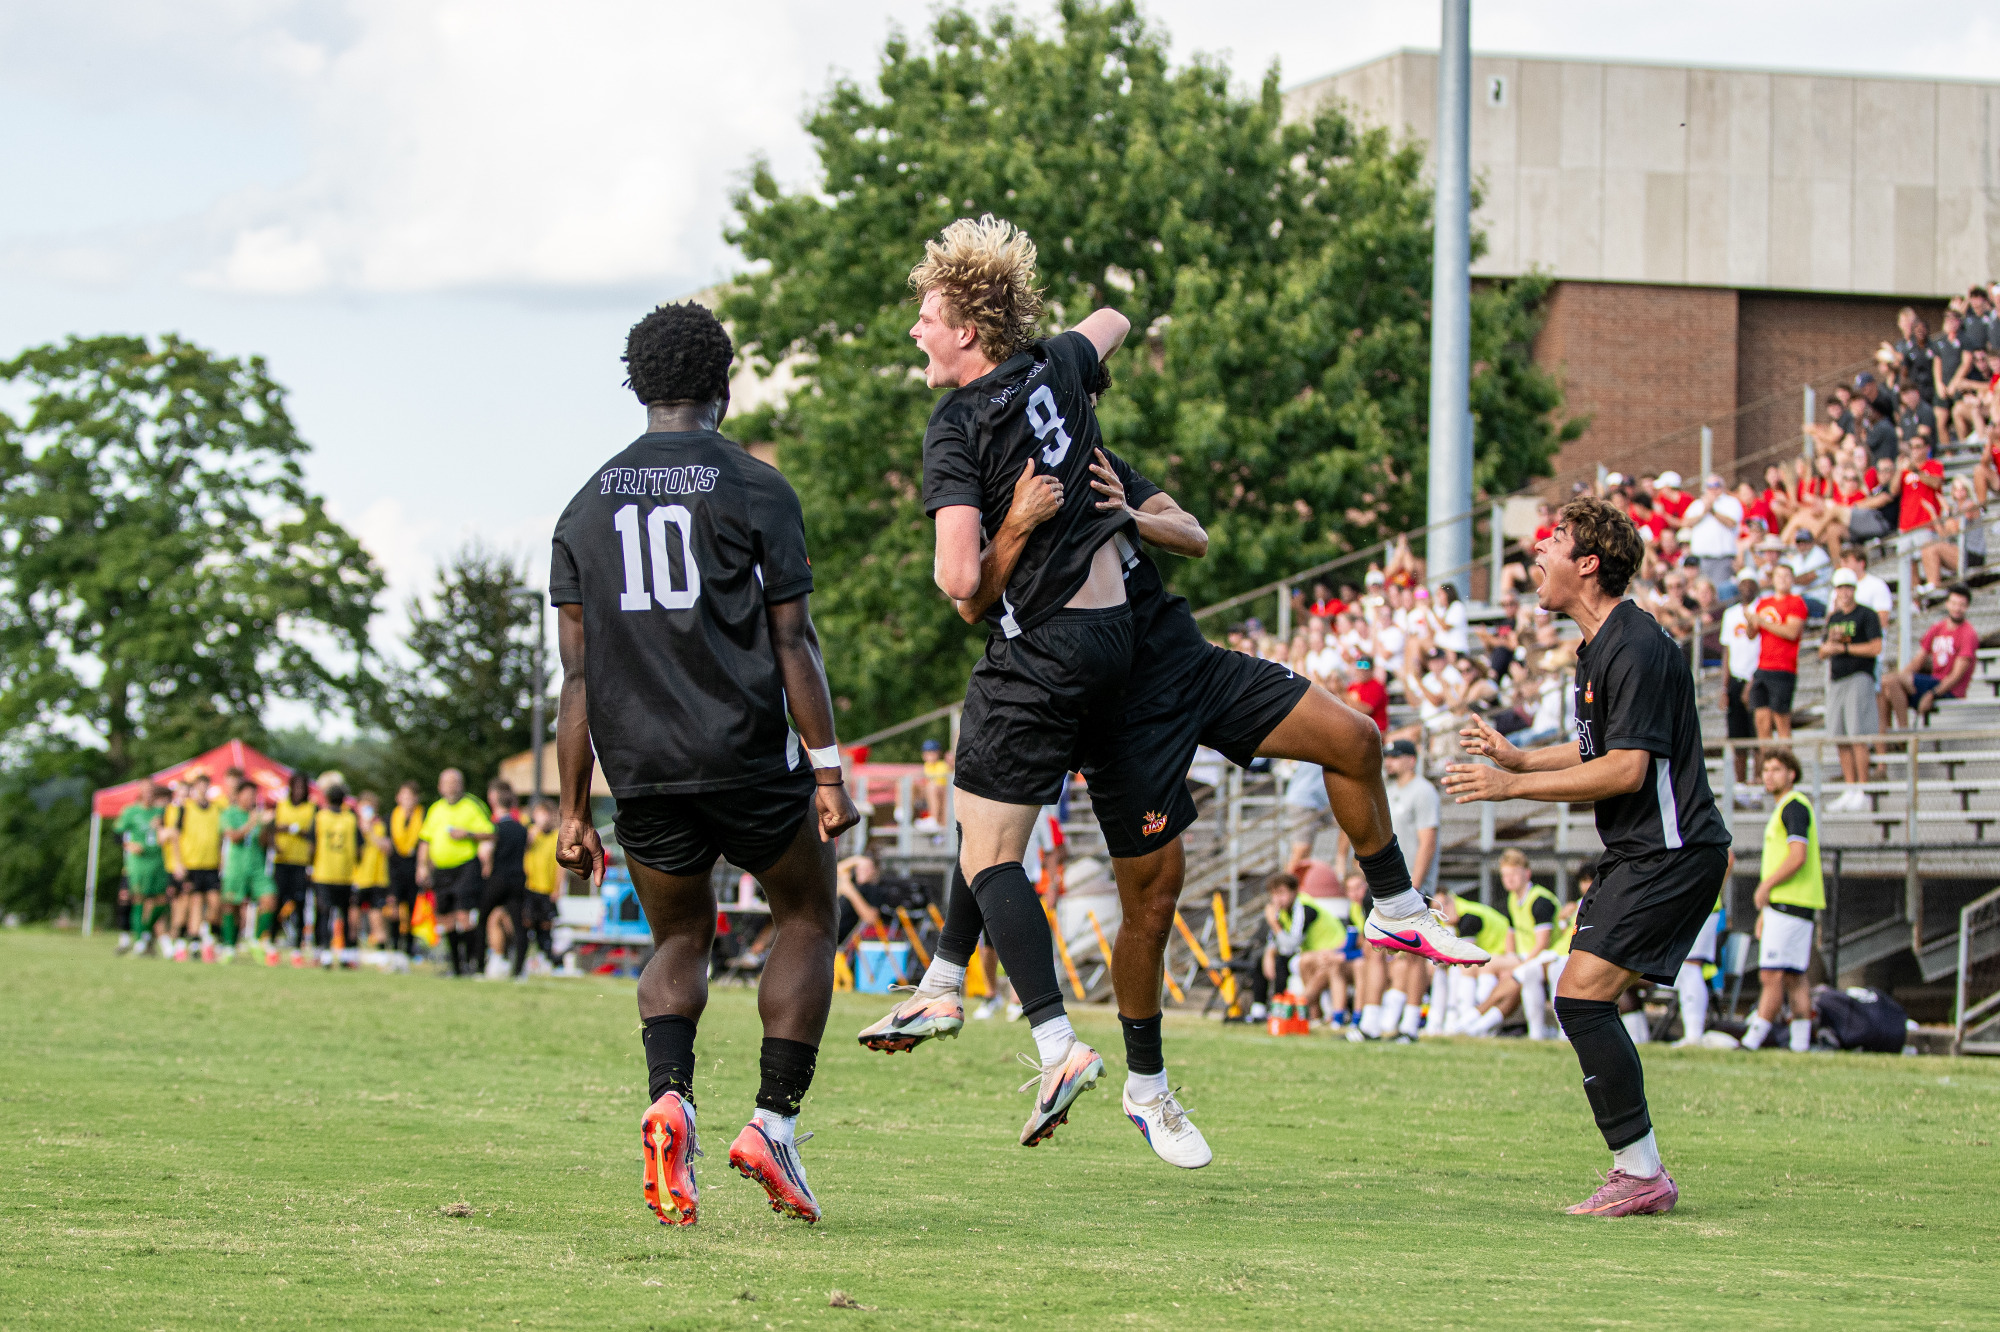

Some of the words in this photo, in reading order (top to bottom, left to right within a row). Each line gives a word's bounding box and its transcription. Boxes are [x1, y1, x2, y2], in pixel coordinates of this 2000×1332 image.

[1026, 384, 1072, 468] 9
[601, 465, 720, 496] TRITONS
[614, 504, 701, 612] 10
